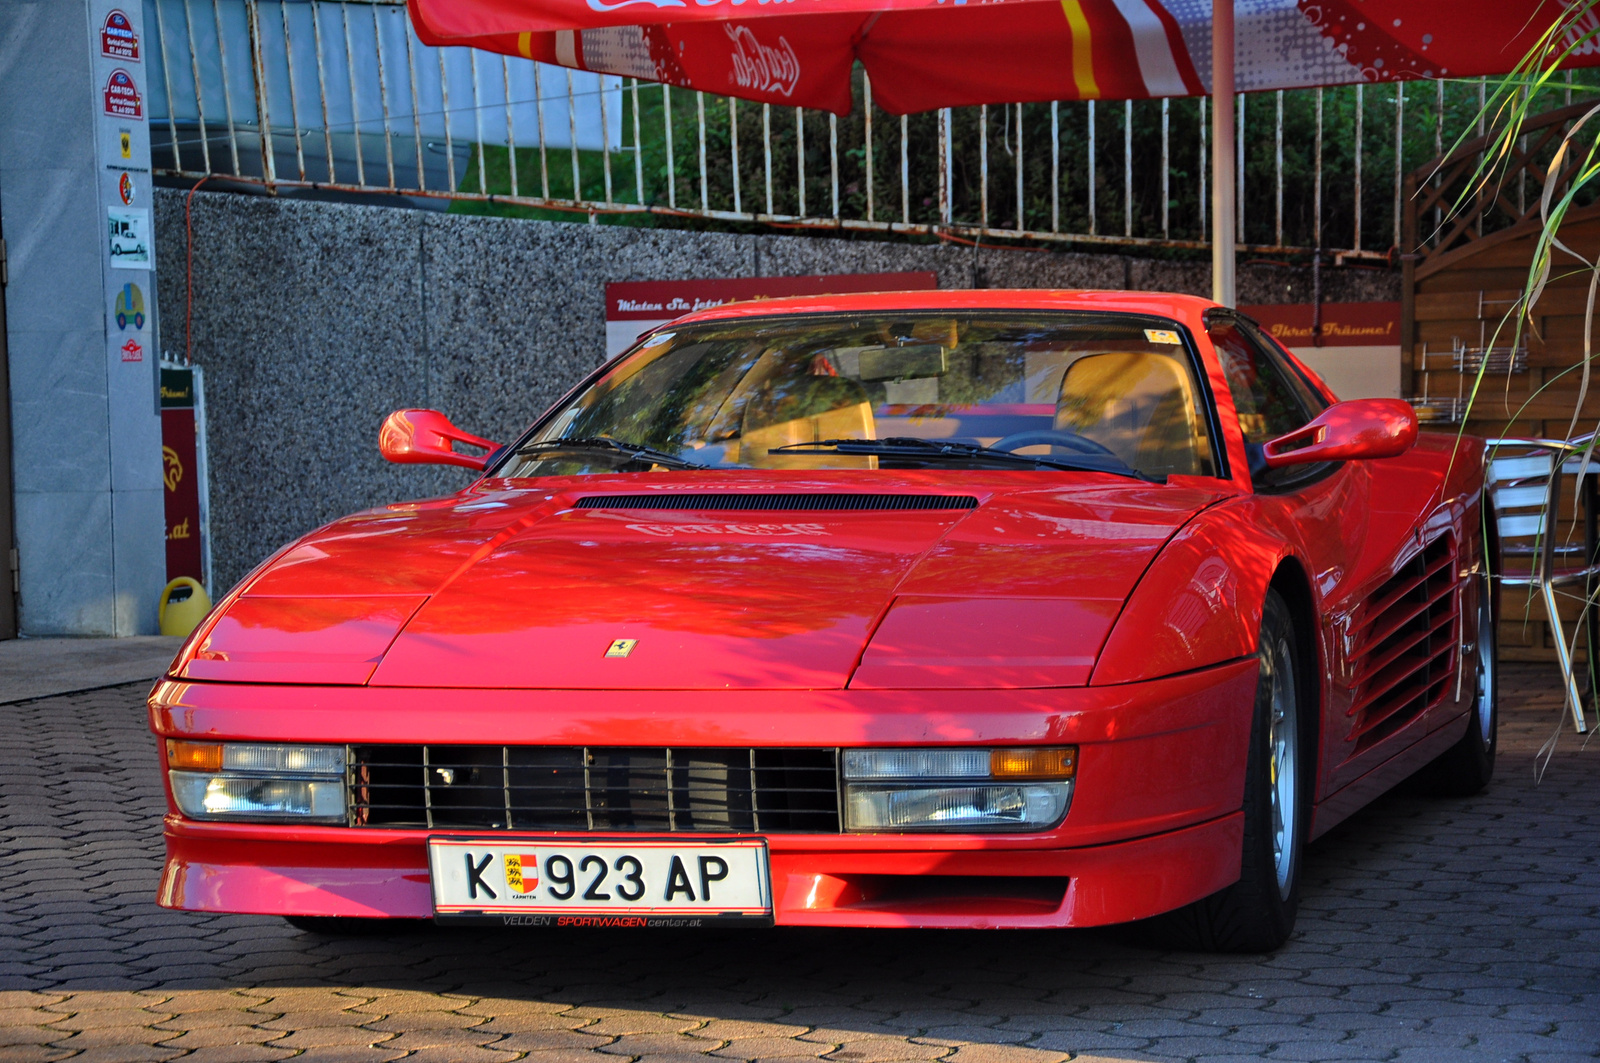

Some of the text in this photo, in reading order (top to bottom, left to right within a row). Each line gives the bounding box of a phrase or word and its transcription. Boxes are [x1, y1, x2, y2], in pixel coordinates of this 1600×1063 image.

[617, 298, 663, 312] Mieten
[666, 297, 691, 311] Sie
[1322, 321, 1394, 336] Träume!
[464, 852, 730, 902] K 923 AP
[503, 916, 551, 926] VELDEN
